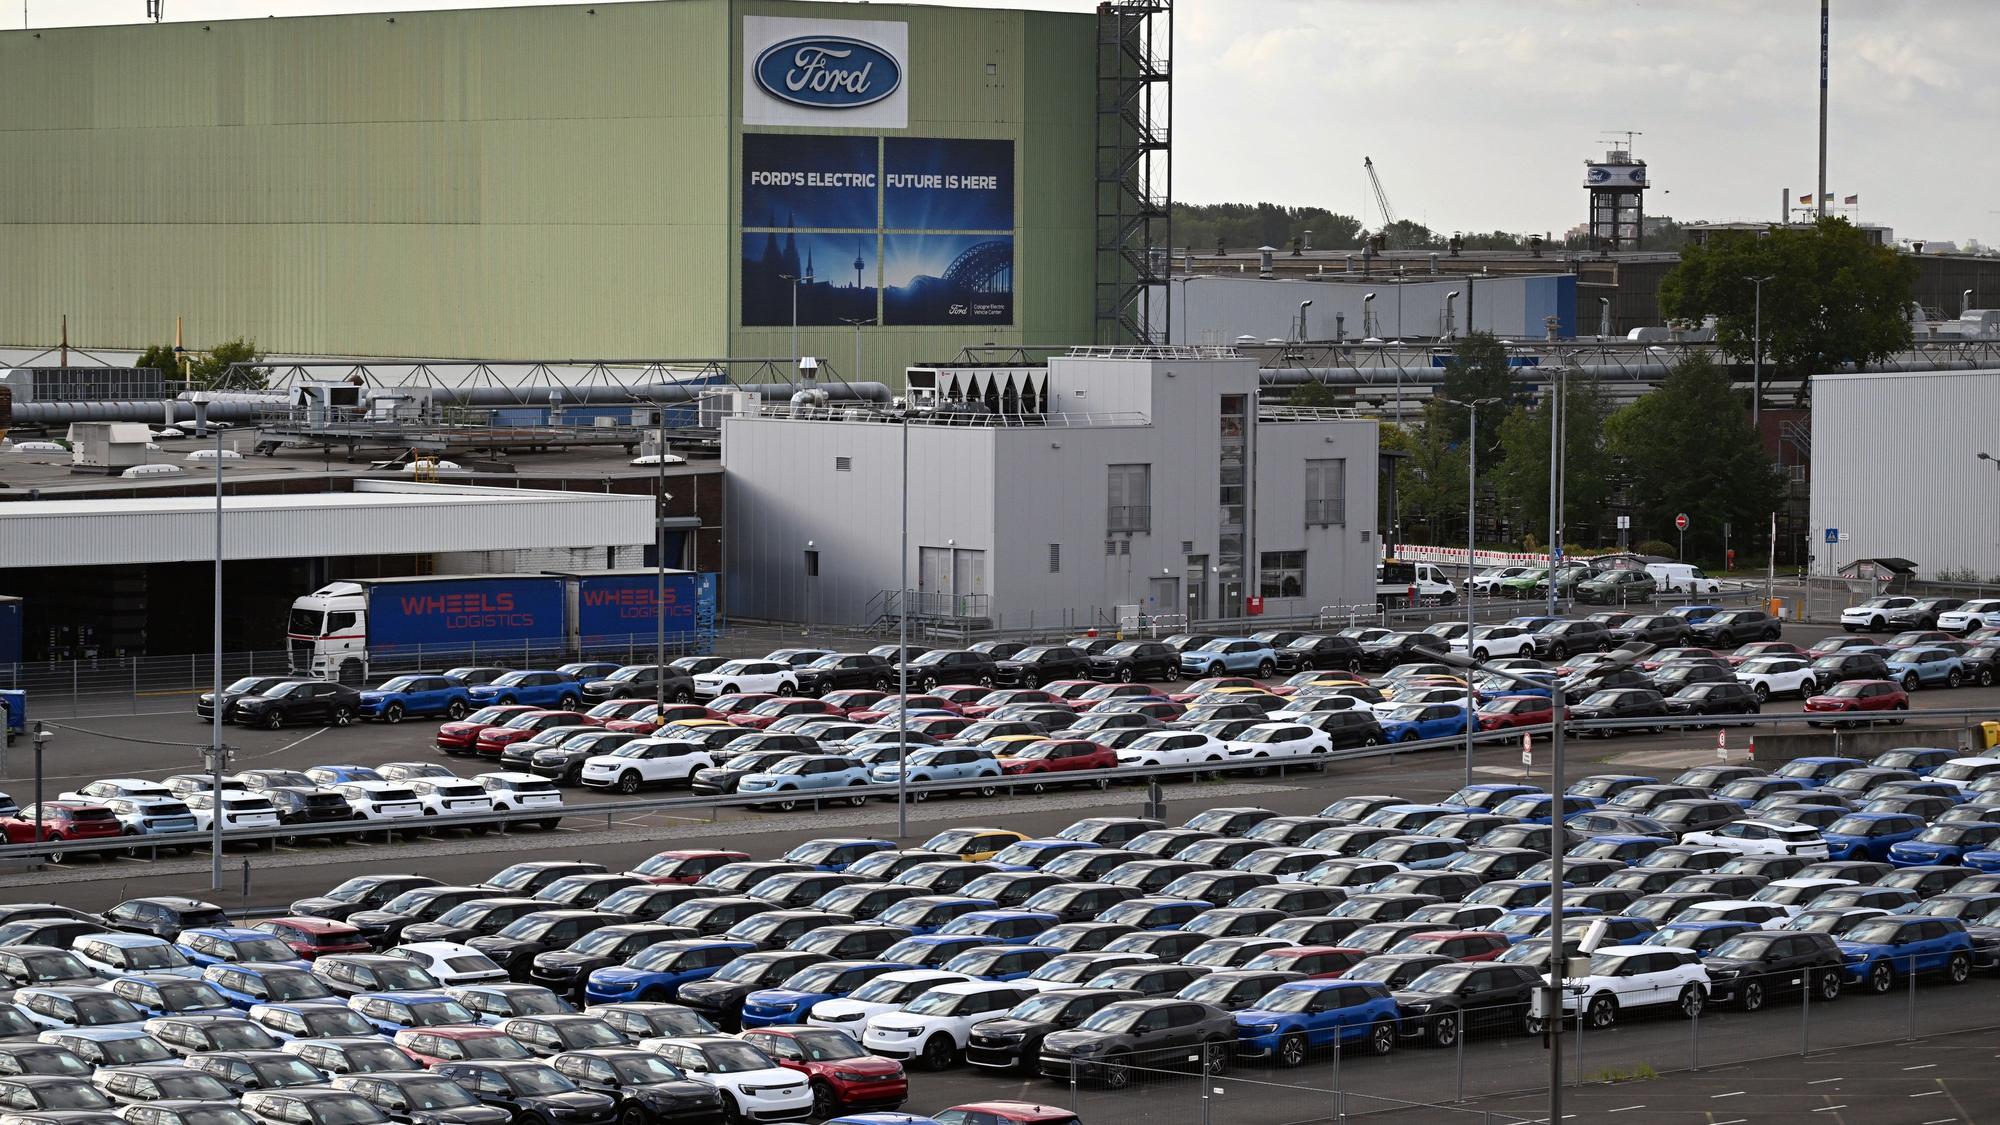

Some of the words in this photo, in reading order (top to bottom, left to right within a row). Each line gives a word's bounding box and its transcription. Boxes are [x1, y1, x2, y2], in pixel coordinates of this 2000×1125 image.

[786, 46, 873, 93] Ford
[751, 171, 805, 187] FORD'S
[807, 172, 876, 188] ELECTRIC
[886, 174, 942, 189] FUTURE
[945, 175, 959, 189] IS
[961, 175, 998, 190] HERE
[948, 304, 968, 315] Ford
[401, 592, 514, 615] WHEELS
[583, 588, 677, 606] WHEELS
[621, 605, 693, 618] LOGISTICS
[447, 613, 534, 629] LOGISTICS
